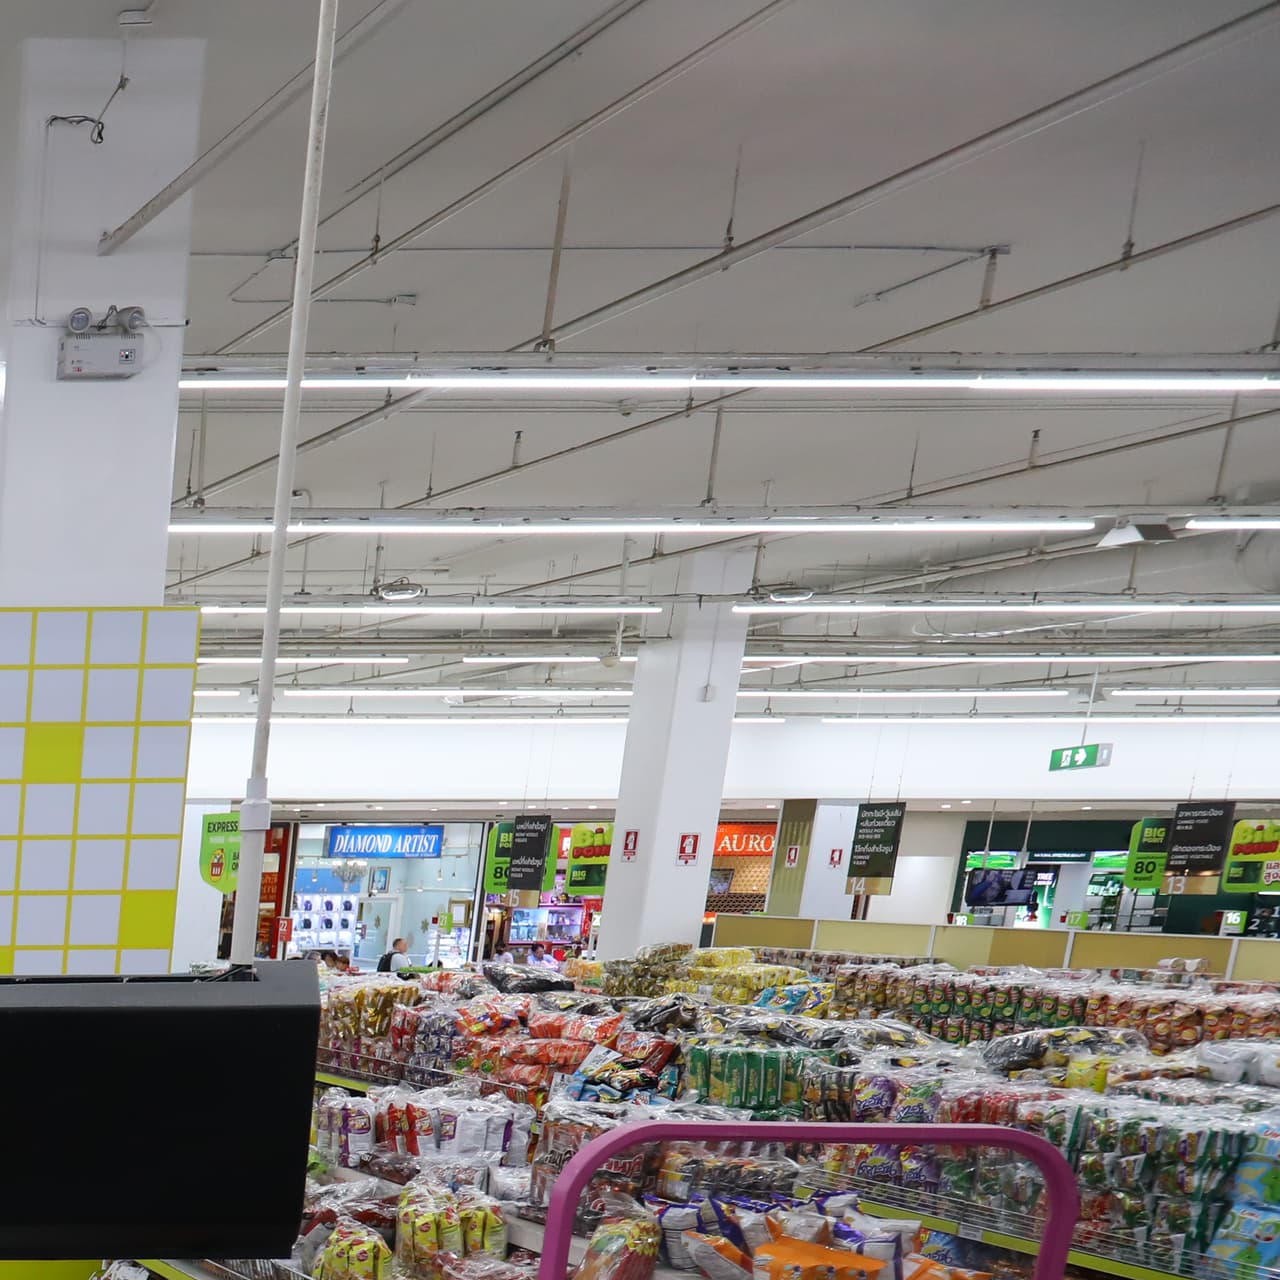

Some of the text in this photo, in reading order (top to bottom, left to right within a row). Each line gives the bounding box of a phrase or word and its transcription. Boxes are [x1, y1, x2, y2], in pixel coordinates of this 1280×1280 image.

[207, 820, 239, 833] EXPRESS
[1143, 827, 1166, 838] BIG
[335, 831, 439, 852] DIAMOND ARTIST
[1134, 861, 1157, 874] 80
[850, 877, 866, 893] 14
[1167, 876, 1186, 895] 13
[1226, 912, 1241, 924] 16
